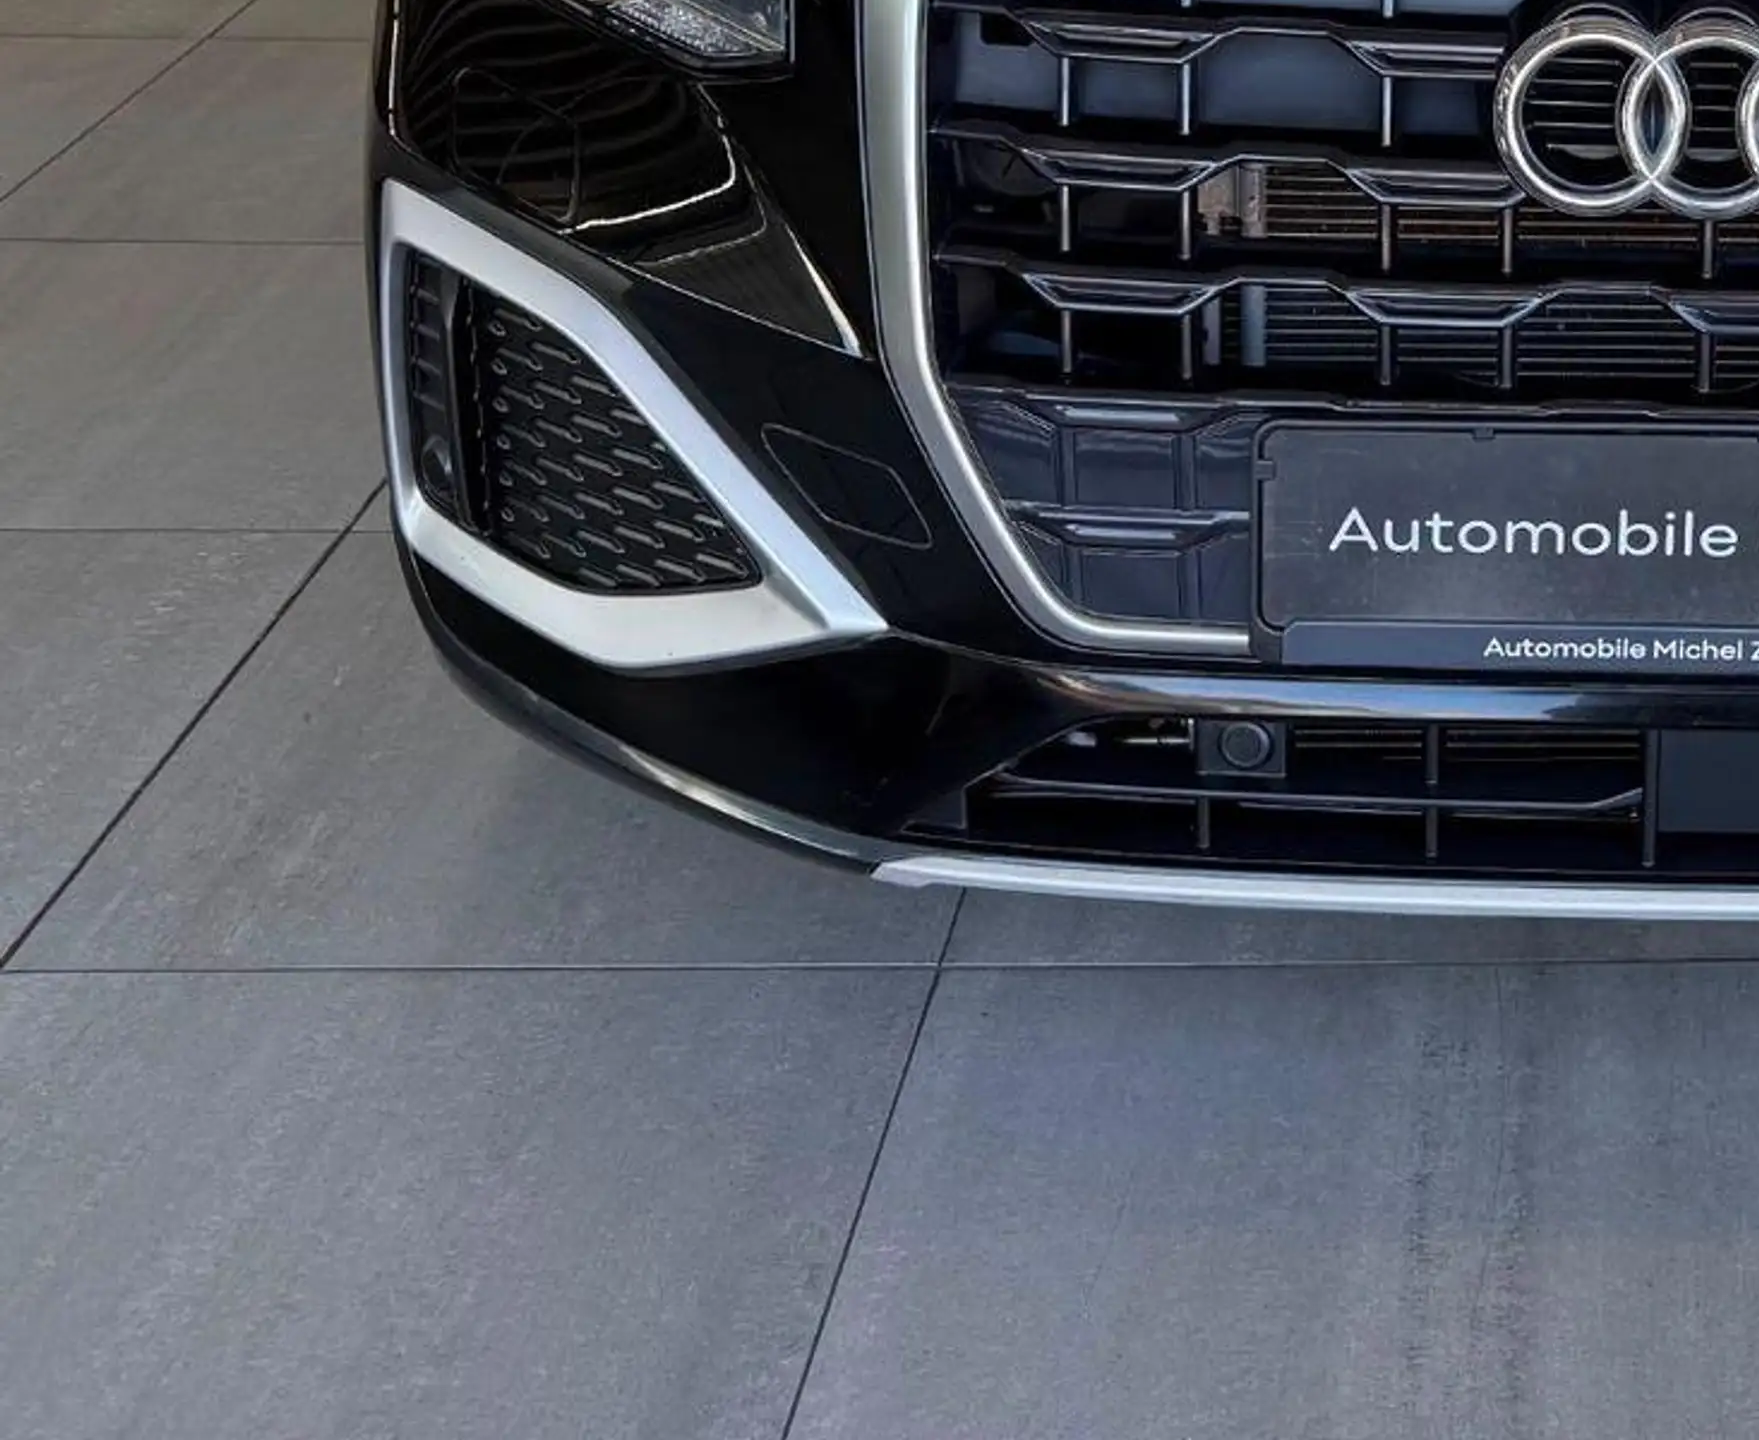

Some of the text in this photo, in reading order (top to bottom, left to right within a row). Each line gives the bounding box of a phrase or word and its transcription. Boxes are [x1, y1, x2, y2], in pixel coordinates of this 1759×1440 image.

[1328, 507, 1739, 558] Automobile
[1483, 636, 1647, 659] Automobile
[1653, 638, 1743, 661] Michel
